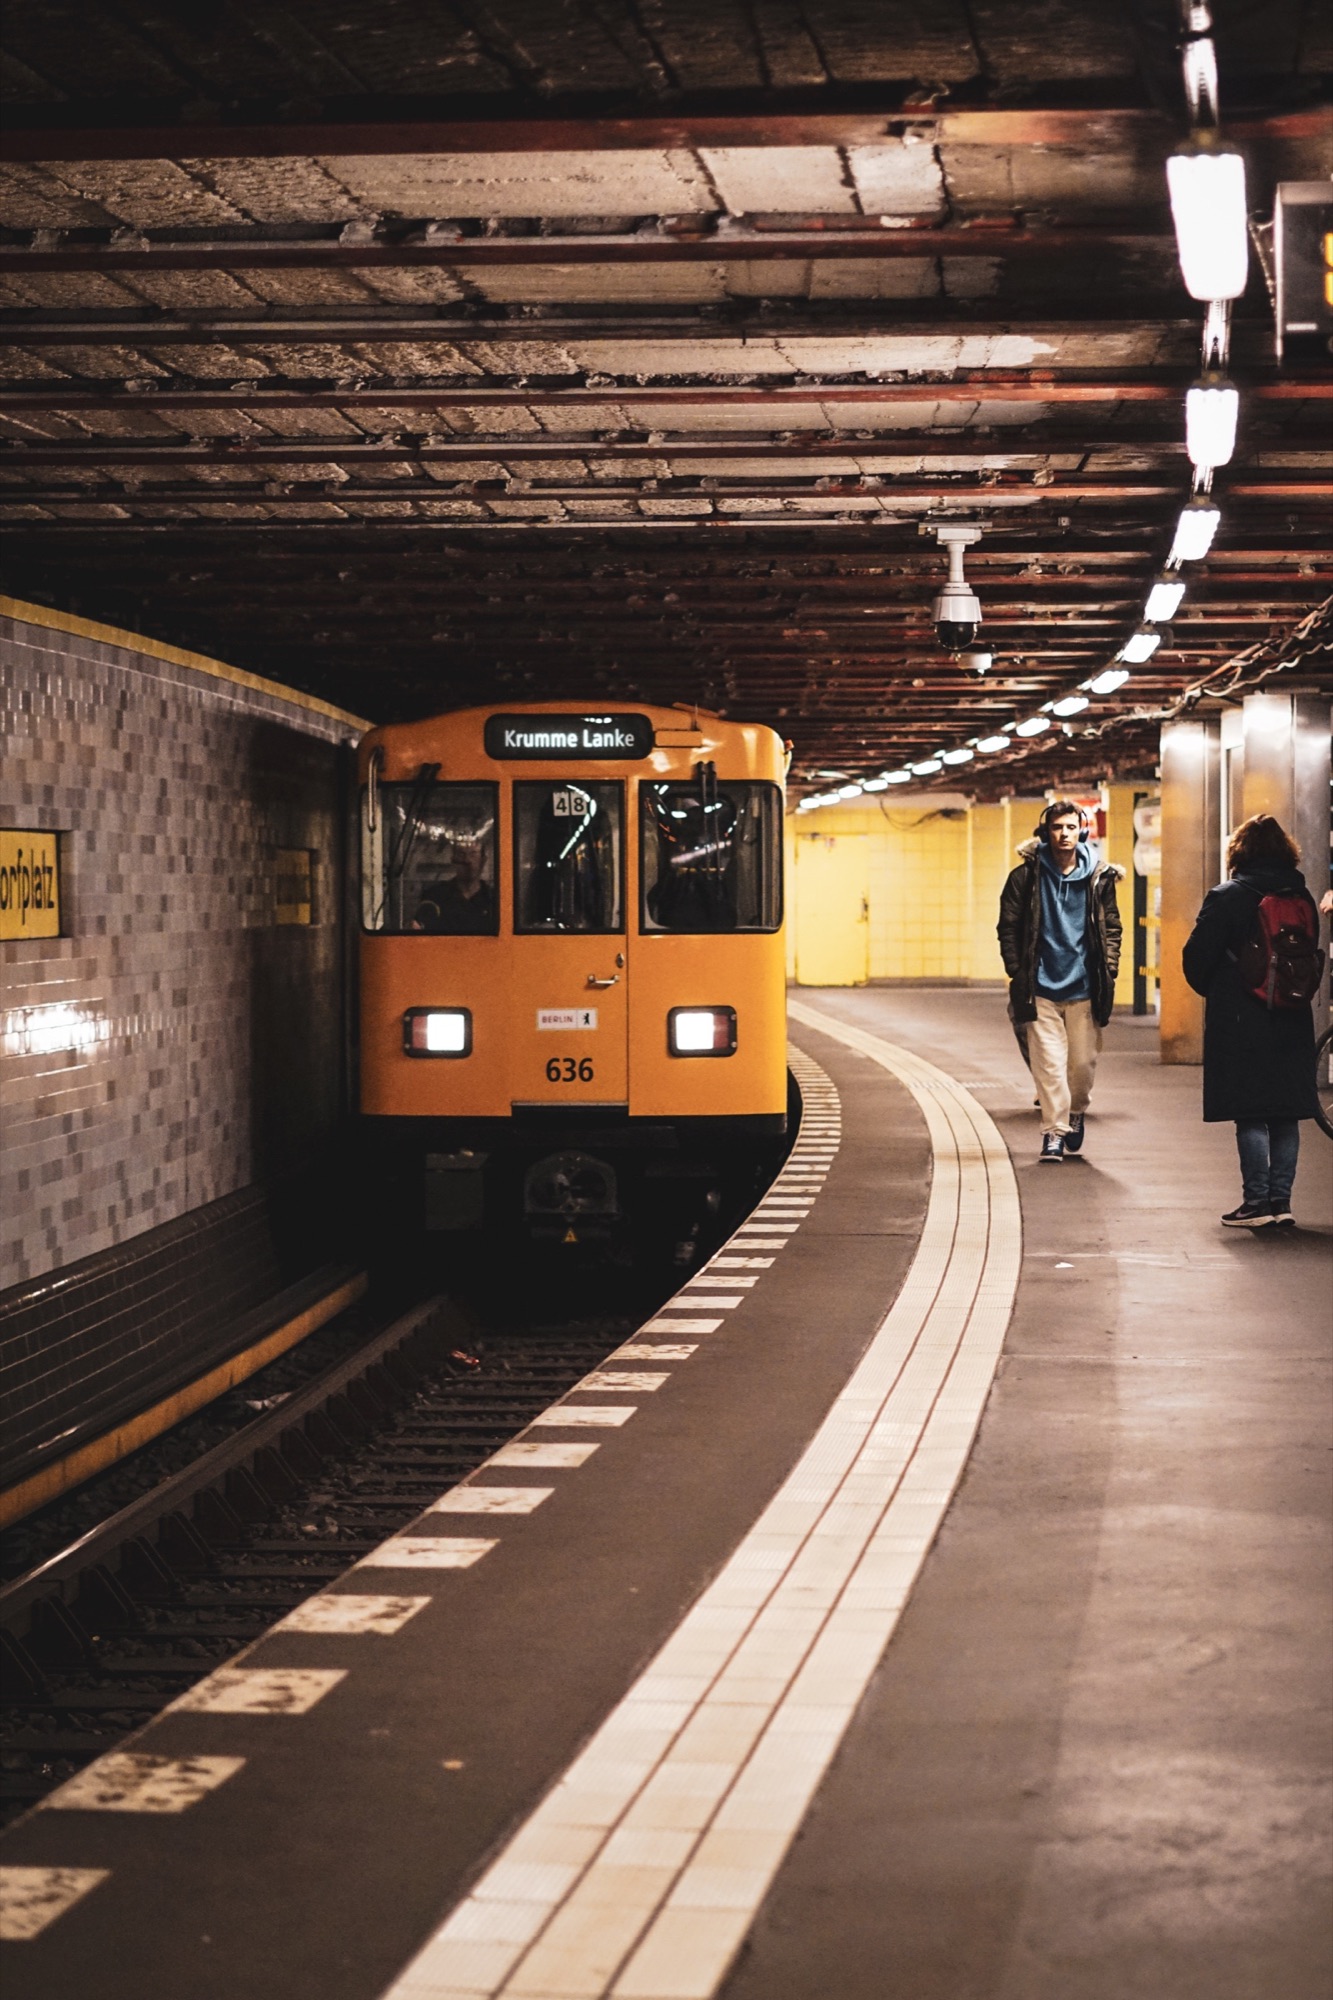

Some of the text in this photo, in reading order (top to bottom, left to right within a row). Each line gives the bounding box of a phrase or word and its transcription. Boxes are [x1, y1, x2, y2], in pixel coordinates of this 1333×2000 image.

[504, 728, 635, 748] Krumme Lanke
[541, 1015, 573, 1024] BERLIN
[545, 1057, 594, 1083] 636
